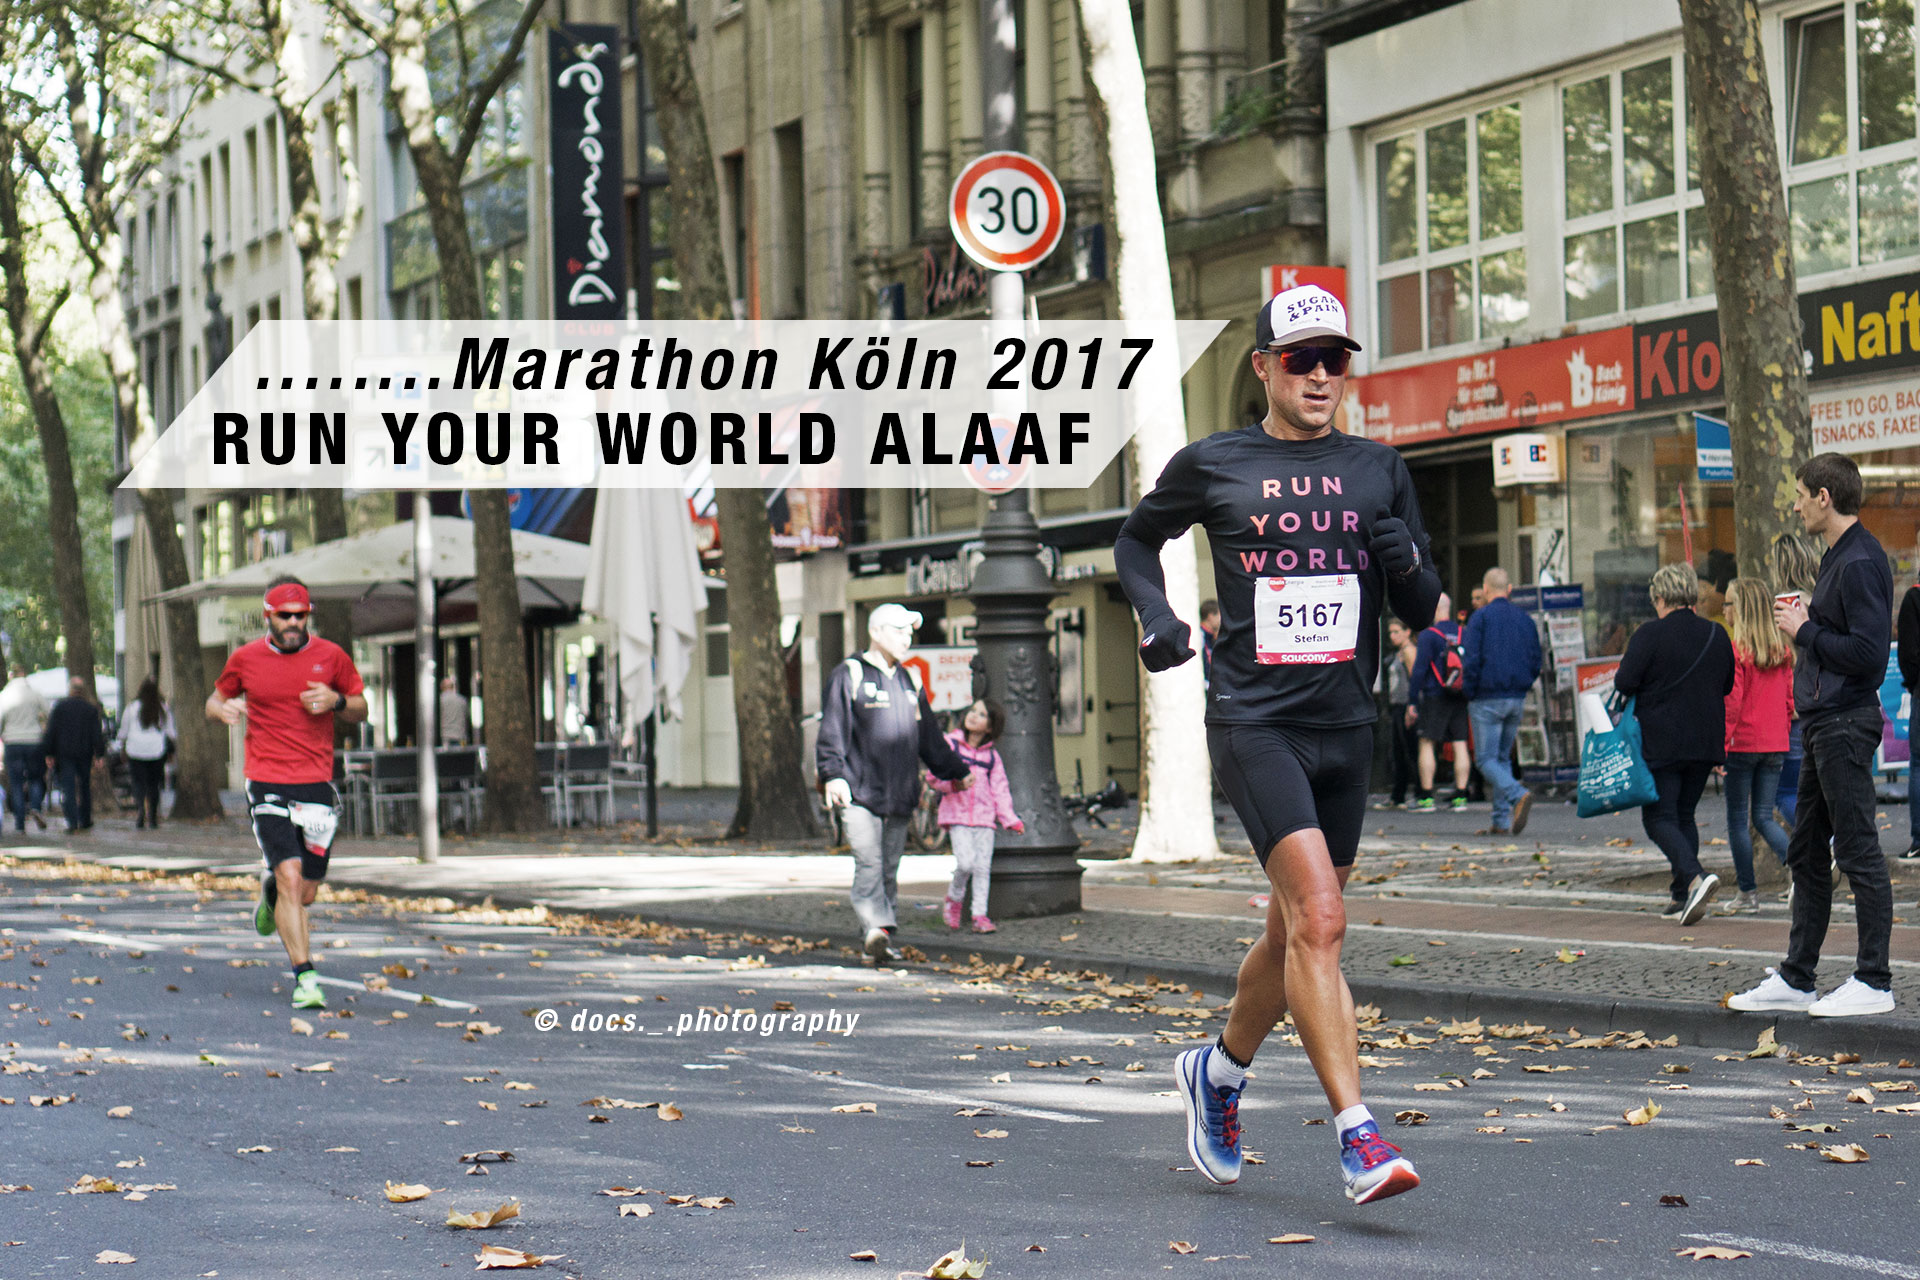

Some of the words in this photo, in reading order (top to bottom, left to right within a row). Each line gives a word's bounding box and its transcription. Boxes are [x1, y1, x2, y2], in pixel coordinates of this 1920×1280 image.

[558, 42, 617, 306] Diamonds
[978, 187, 1039, 236] 30
[1595, 360, 1622, 383] Back
[1847, 396, 1864, 417] TO
[1868, 393, 1893, 415] GO,
[1262, 476, 1343, 499] RUN
[1250, 510, 1359, 536] YOUR
[1239, 548, 1369, 573] WORLD
[1278, 602, 1343, 628] 5167
[1294, 634, 1329, 644] Stefan
[1281, 653, 1327, 664] saucony
